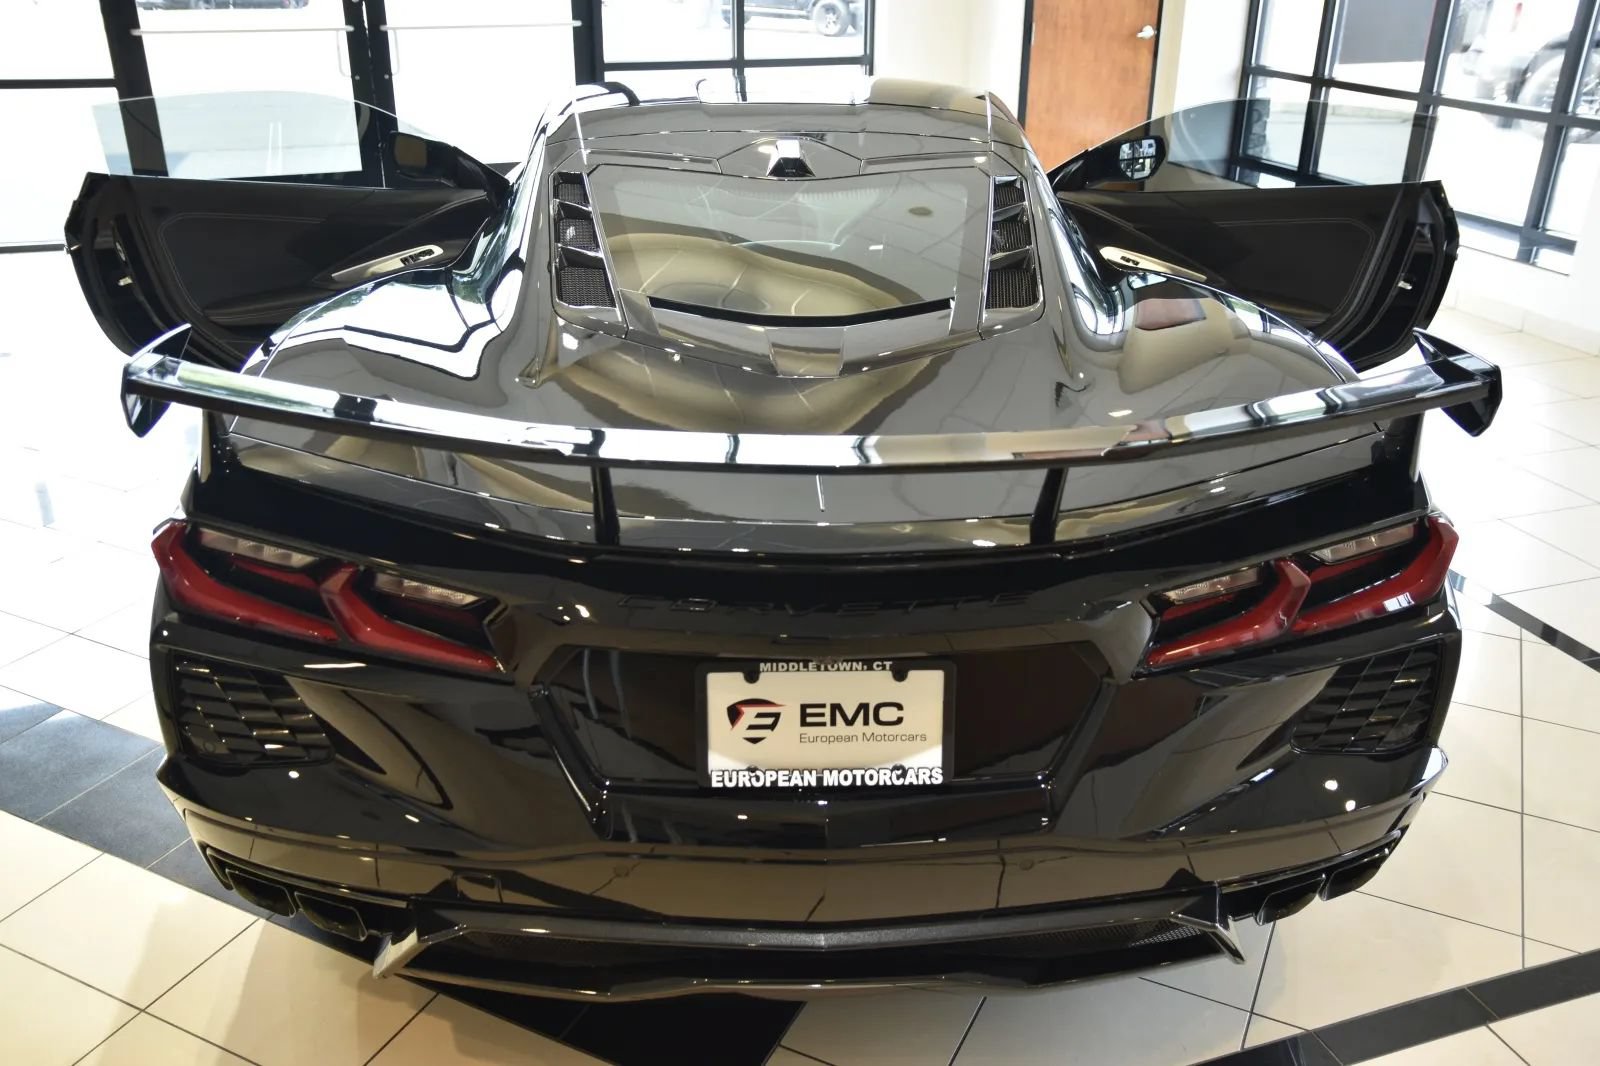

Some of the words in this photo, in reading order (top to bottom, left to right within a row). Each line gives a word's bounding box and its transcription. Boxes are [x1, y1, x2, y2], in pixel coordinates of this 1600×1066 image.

[872, 660, 893, 671] CT
[799, 702, 904, 728] EMC
[799, 732, 859, 745] European
[862, 732, 927, 743] Motorcars
[711, 769, 818, 789] EUROPEAN
[823, 766, 944, 787] MOTORCARS
